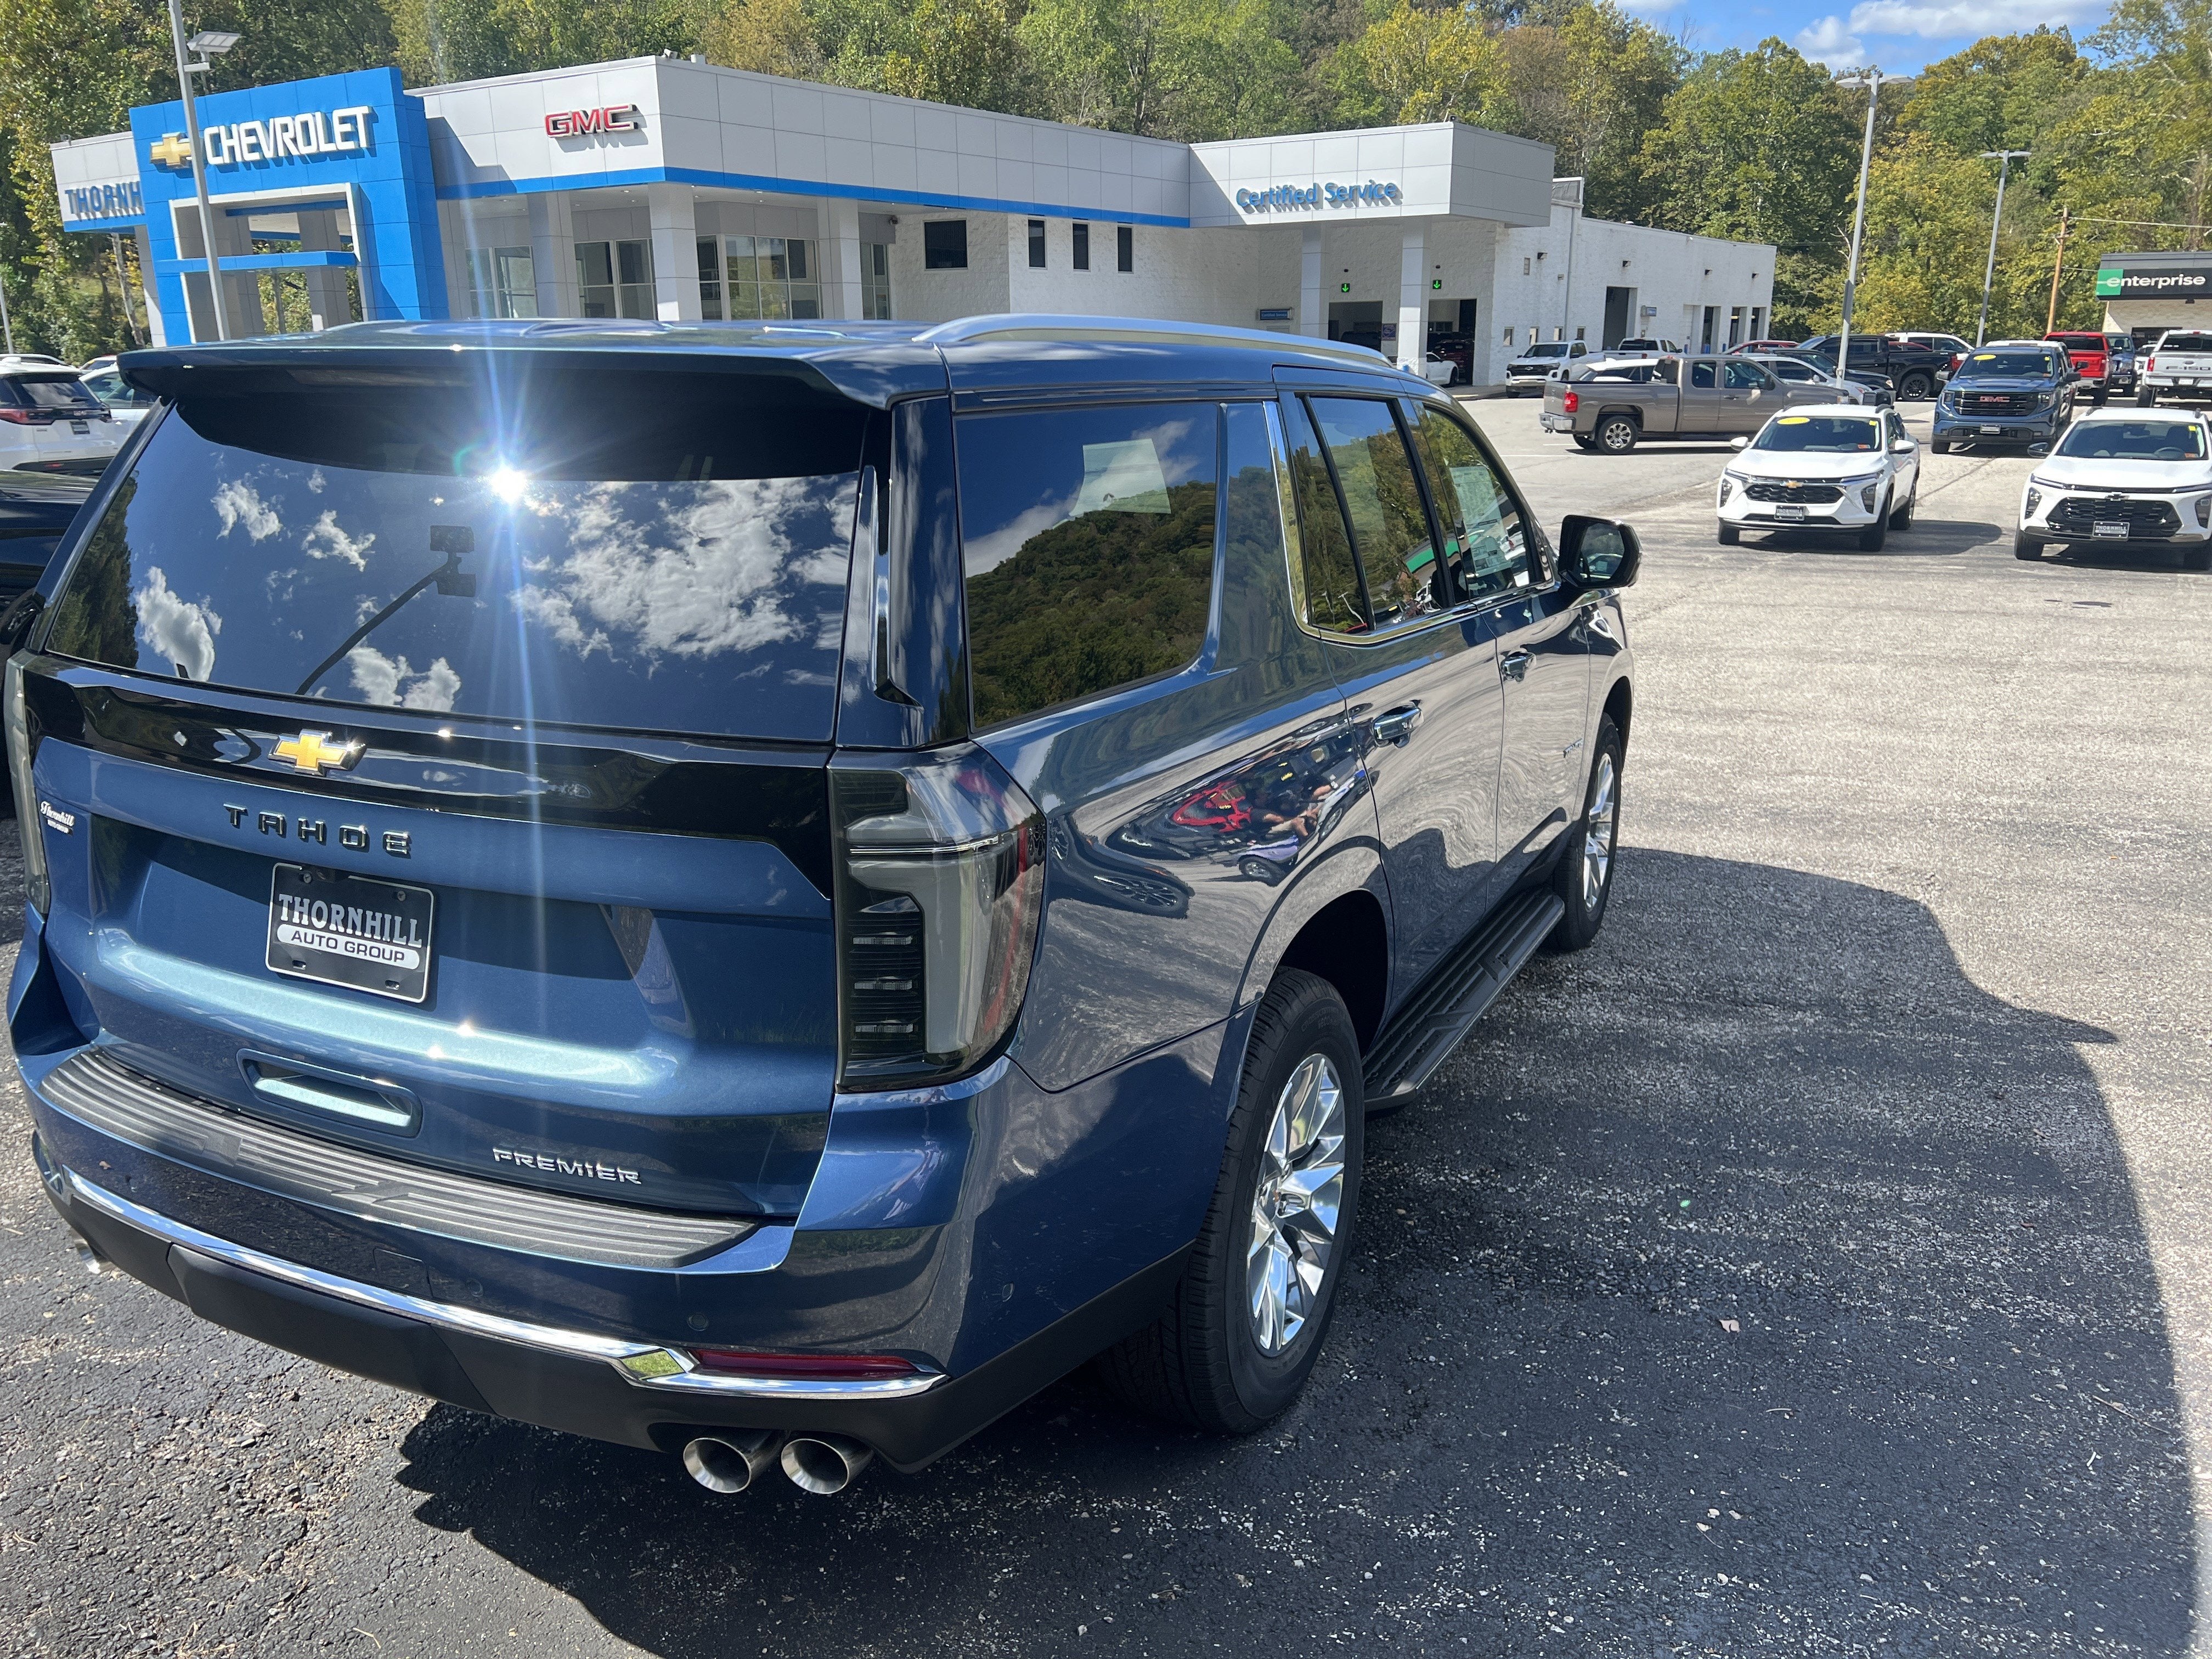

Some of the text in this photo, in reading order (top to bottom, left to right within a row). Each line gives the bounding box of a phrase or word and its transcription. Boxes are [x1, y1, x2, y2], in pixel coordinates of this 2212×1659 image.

[204, 105, 370, 165] CHEVROLET
[544, 104, 635, 138] GMC
[1236, 179, 1398, 207] Certified Service
[2106, 273, 2206, 289] enterprise
[223, 803, 410, 855] TAHOE
[278, 893, 422, 949] THORNHILL
[291, 930, 405, 962] AUTO GROUP
[492, 1147, 642, 1184] PREMIER
